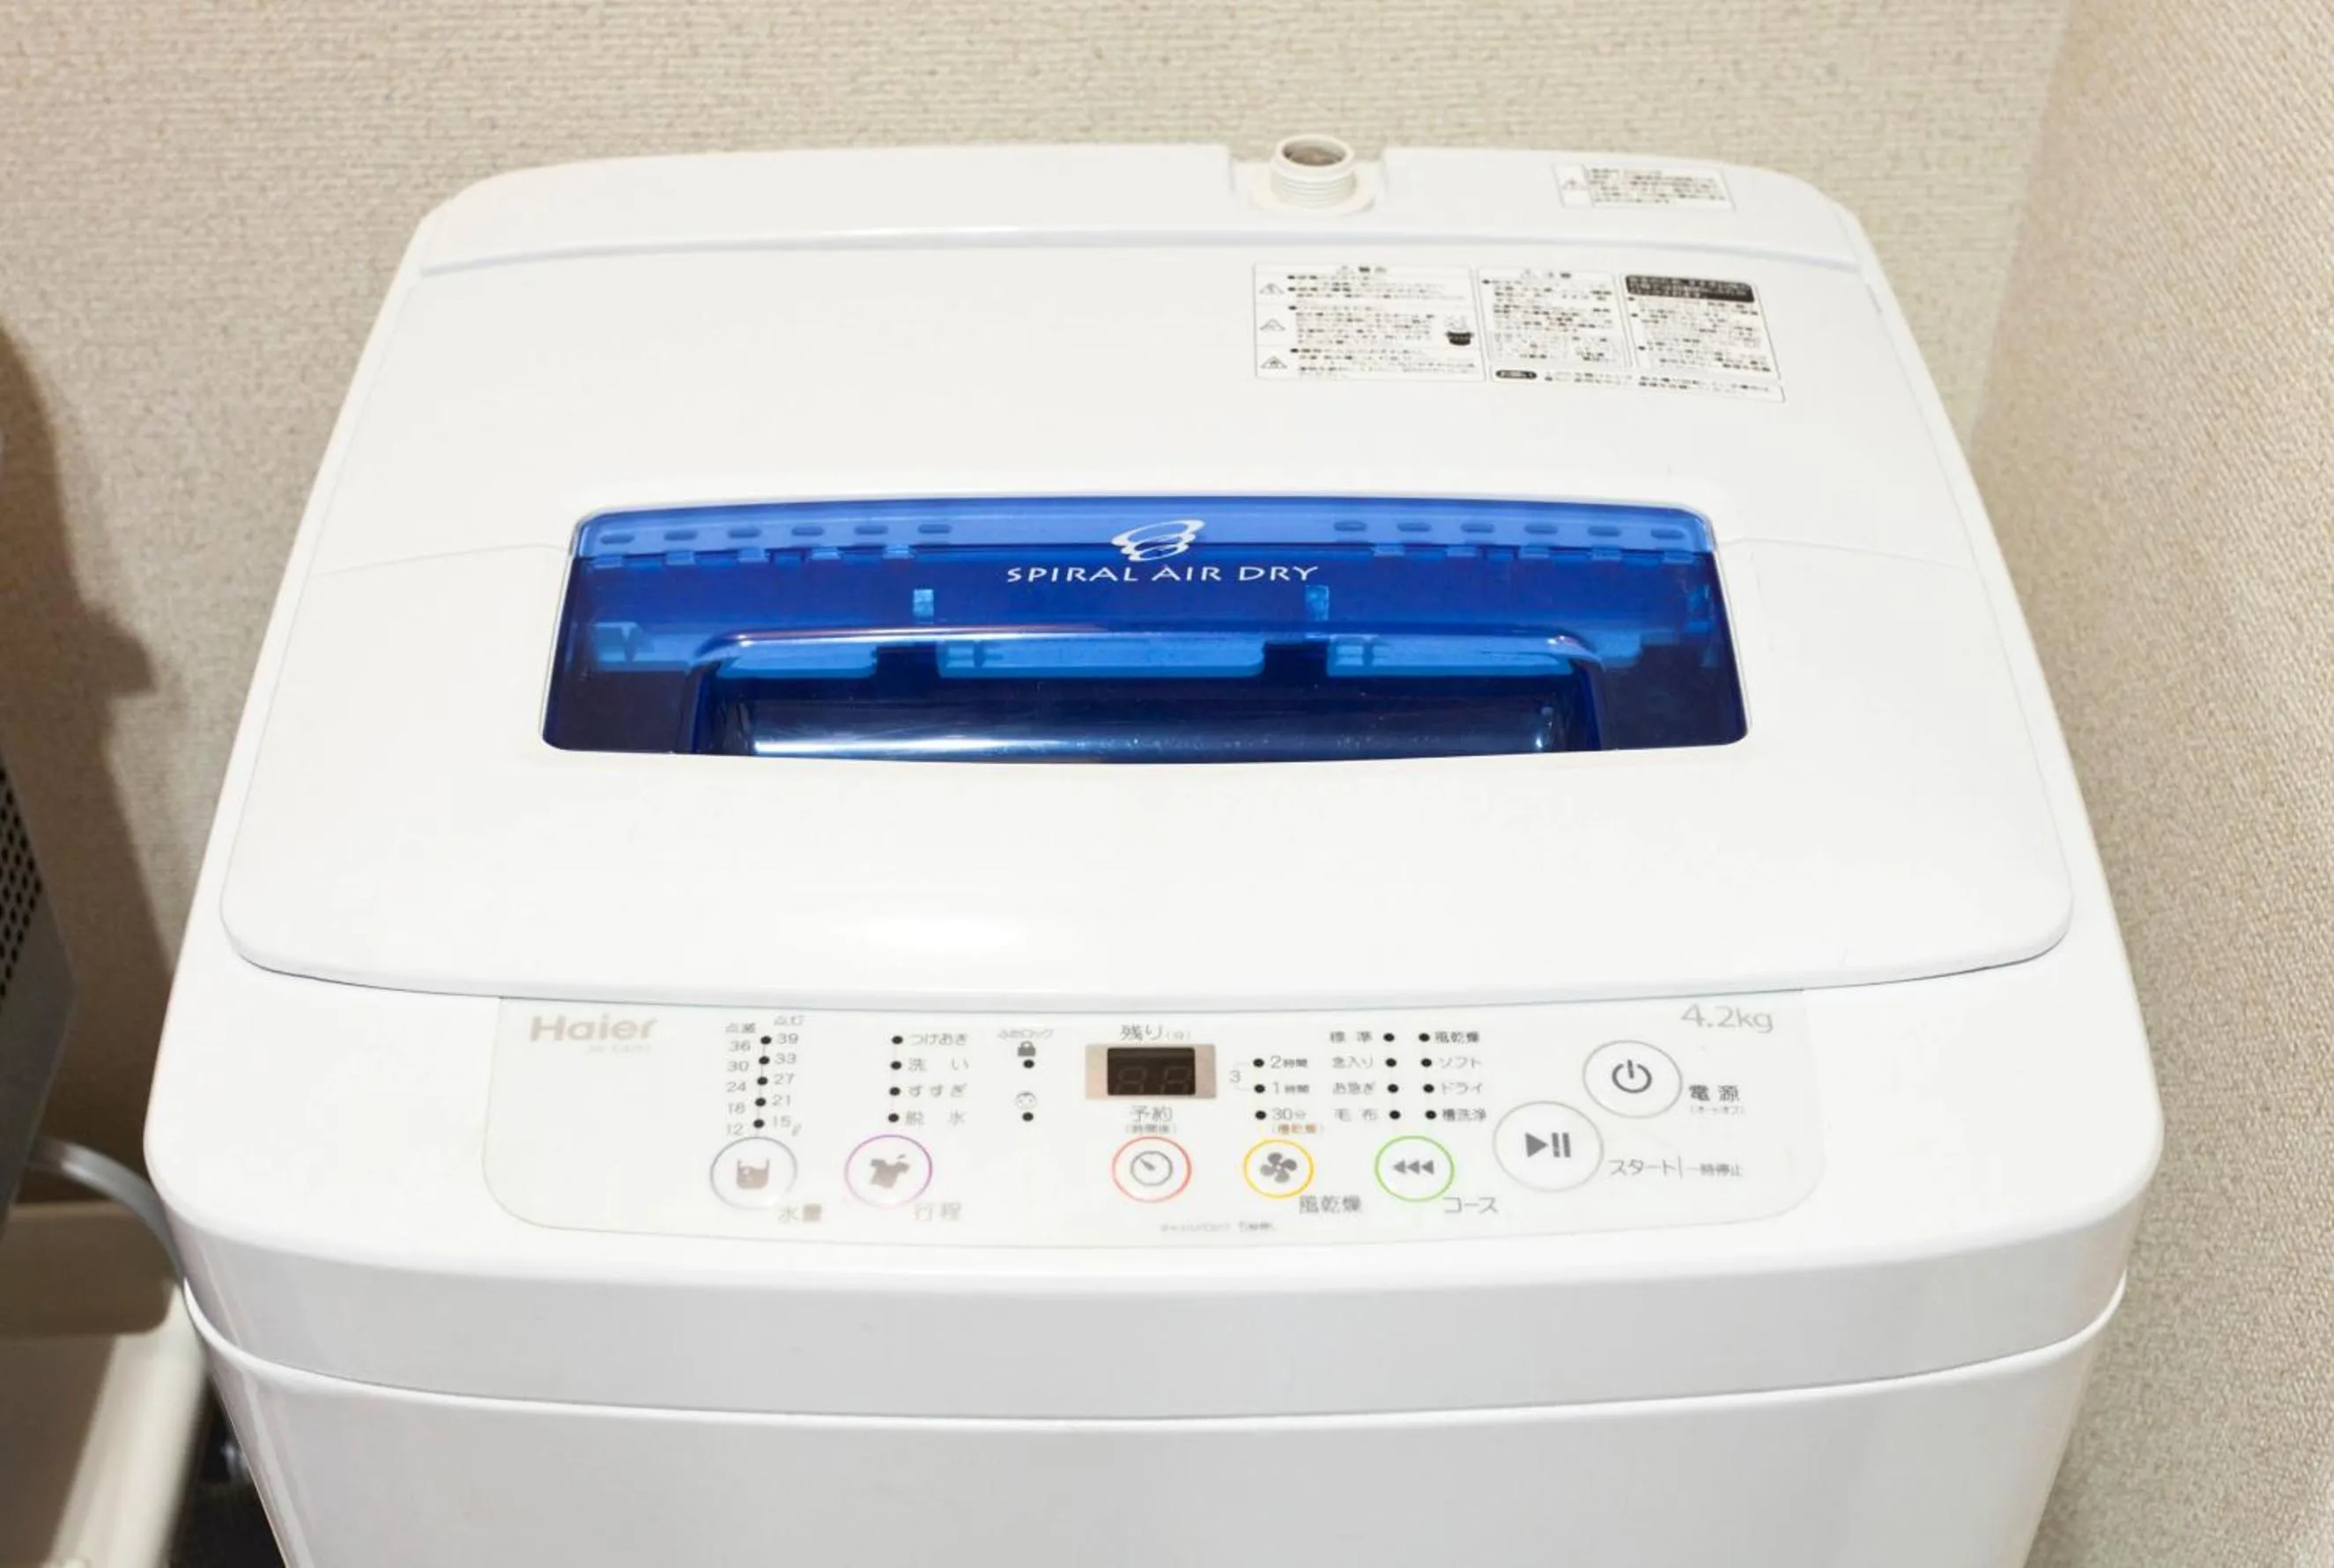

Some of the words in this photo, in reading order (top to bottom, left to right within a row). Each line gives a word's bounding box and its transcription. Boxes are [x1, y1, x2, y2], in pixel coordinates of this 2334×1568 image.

[1007, 566, 1138, 582] SPIRAL
[1152, 565, 1221, 581] AIR
[1239, 566, 1318, 581] DRY
[1680, 1003, 1774, 1033] 4.2kg
[530, 1013, 659, 1042] Haier
[726, 1060, 750, 1072] 30
[1440, 1056, 1482, 1069] ソフト
[773, 1073, 794, 1085] 27
[1229, 1069, 1241, 1084] 3
[724, 1080, 746, 1092] 24
[1441, 1082, 1483, 1095] ドライ
[772, 1094, 791, 1106] 21
[726, 1123, 745, 1135] 12
[1608, 1158, 1677, 1177] スタート
[1299, 1194, 1362, 1215] 風乾燥
[1443, 1195, 1498, 1214] コース
